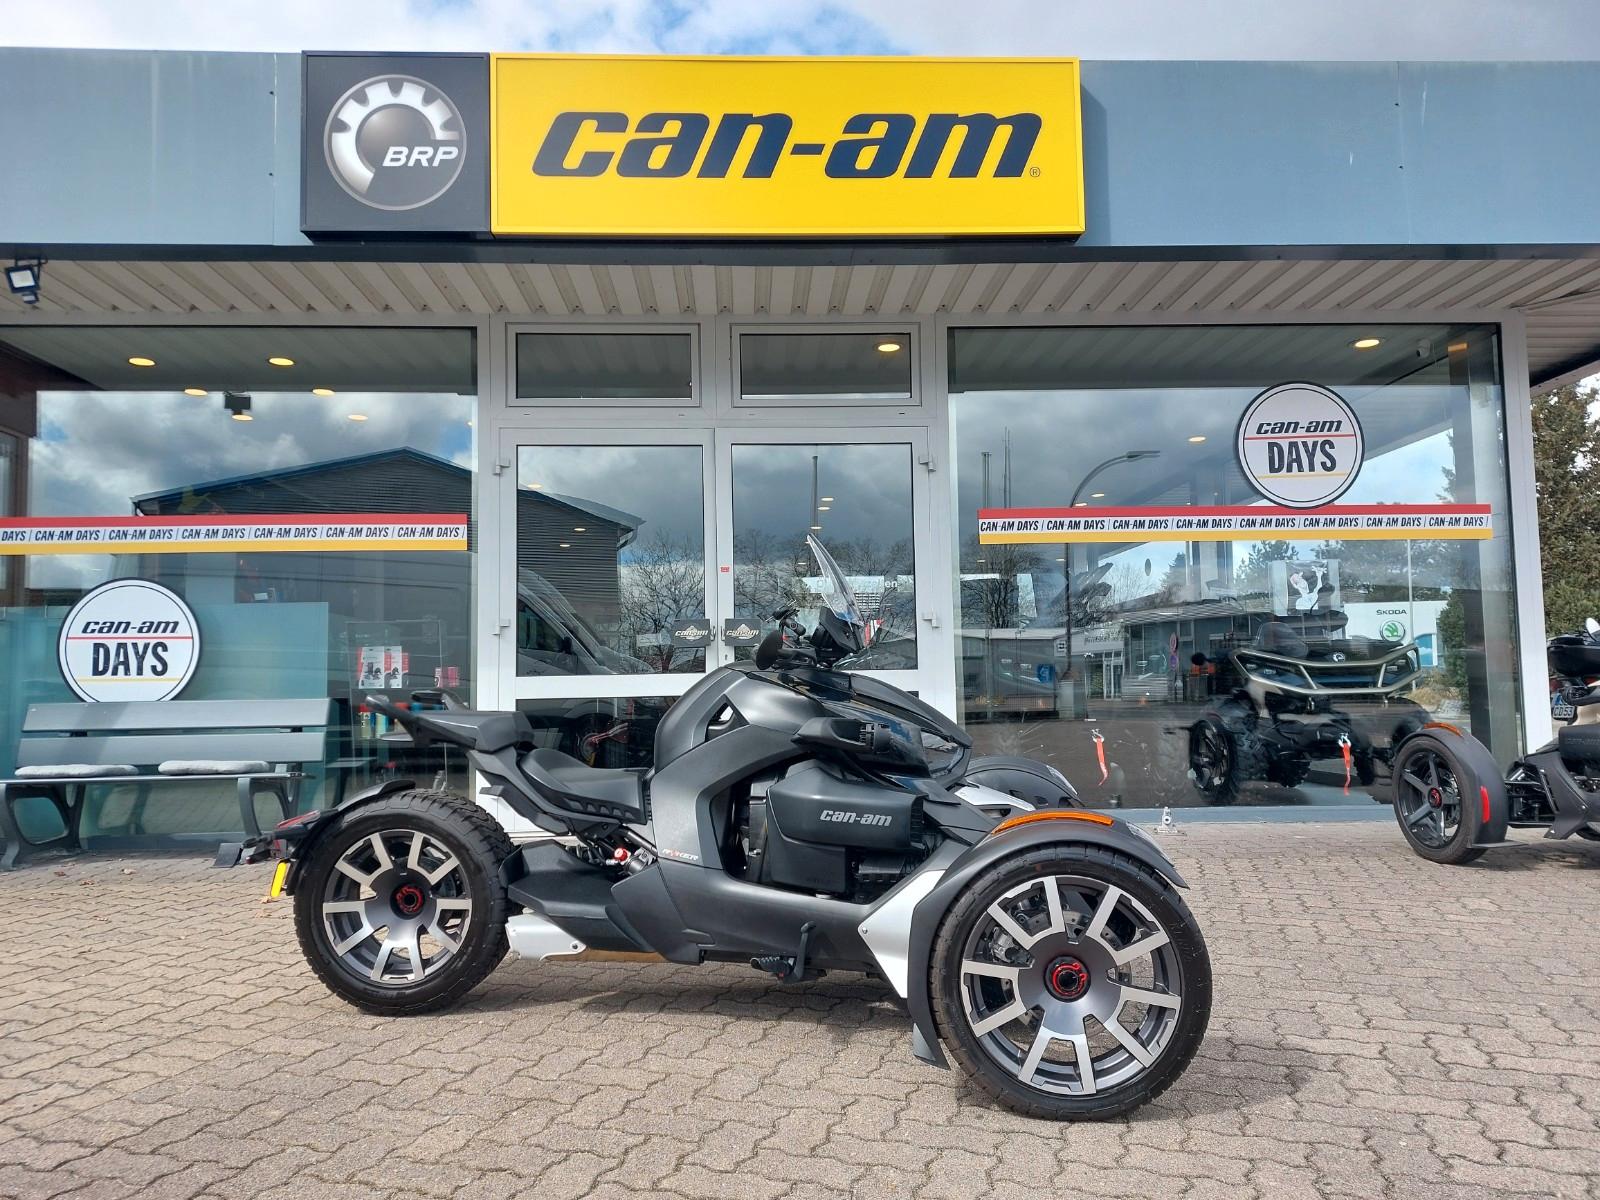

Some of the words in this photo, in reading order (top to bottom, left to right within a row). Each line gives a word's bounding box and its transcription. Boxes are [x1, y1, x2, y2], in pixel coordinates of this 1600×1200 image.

[531, 111, 1043, 178] can-am
[382, 146, 459, 167] BRP
[1256, 420, 1343, 435] can-am
[1267, 439, 1337, 474] DAYS
[980, 521, 1015, 532] CAN-AM
[1016, 521, 1039, 531] DAYS
[1046, 520, 1081, 531] CAN-AM
[1083, 520, 1106, 530] DAYS
[1112, 519, 1146, 530] CAN-AM
[1147, 519, 1169, 530] DAYS
[1176, 519, 1209, 529] CAN-AM
[1211, 518, 1233, 529] DAYS
[1239, 518, 1273, 529] CAN-AM
[1274, 518, 1296, 528] DAYS
[1303, 517, 1336, 528] CAN-AM
[1338, 517, 1359, 527] DAYS
[1366, 517, 1399, 527] CAN-AM
[1400, 517, 1422, 527] DAYS
[1428, 517, 1462, 527] CAN-AM
[1463, 516, 1484, 527] DAYS
[1, 530, 26, 541] DAYS
[35, 530, 73, 541] CAN-AM
[75, 529, 100, 541] DAYS
[108, 529, 147, 540] CAN-AM
[149, 529, 173, 540] DAYS
[181, 528, 219, 540] CAN-AM
[221, 528, 245, 539] DAYS
[254, 528, 291, 539] CAN-AM
[294, 527, 318, 538] DAYS
[325, 527, 363, 538] CAN-AM
[365, 527, 389, 538] DAYS
[397, 527, 434, 538] CAN-AM
[436, 527, 460, 537] DAYS
[81, 620, 179, 634] can-am
[91, 641, 169, 677] DAYS
[820, 810, 893, 826] can-am
